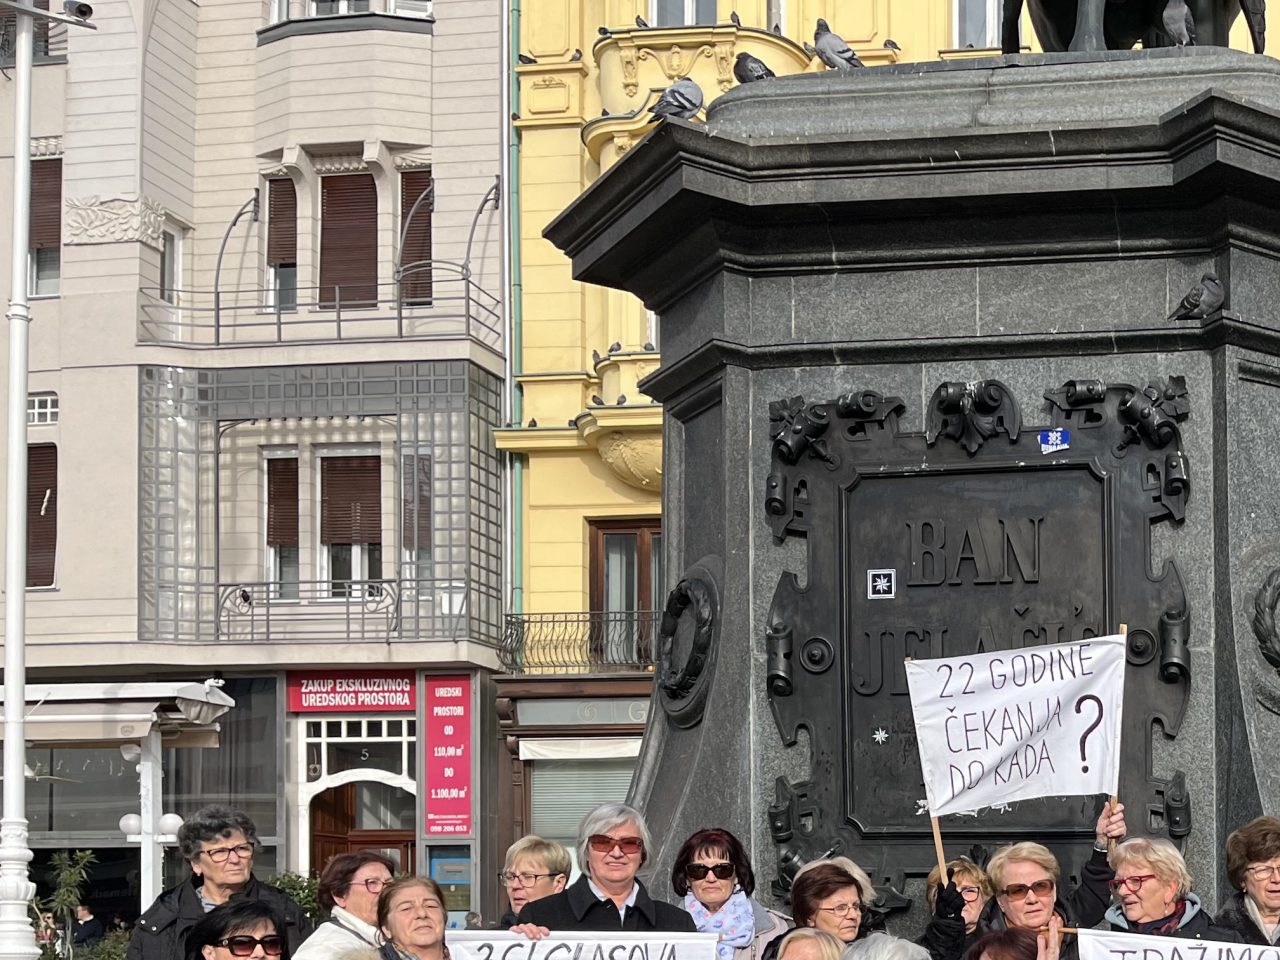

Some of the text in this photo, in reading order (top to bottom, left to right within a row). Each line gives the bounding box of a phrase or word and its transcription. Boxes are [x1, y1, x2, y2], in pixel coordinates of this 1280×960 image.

[905, 515, 1044, 586] BAN
[937, 662, 975, 698] 22
[989, 643, 1093, 690] GODINE
[301, 678, 410, 693] ZAKUP EKSKLUZIVNOG
[435, 687, 462, 697] UREDSKI
[302, 692, 410, 706] UREDSKOG PROSTORA
[433, 706, 464, 716] PROSTORI
[444, 725, 453, 735] OD
[945, 696, 1062, 753] ČEKANJA
[360, 748, 369, 761] 5
[444, 767, 453, 777] DO
[949, 739, 1055, 799] DO KADA
